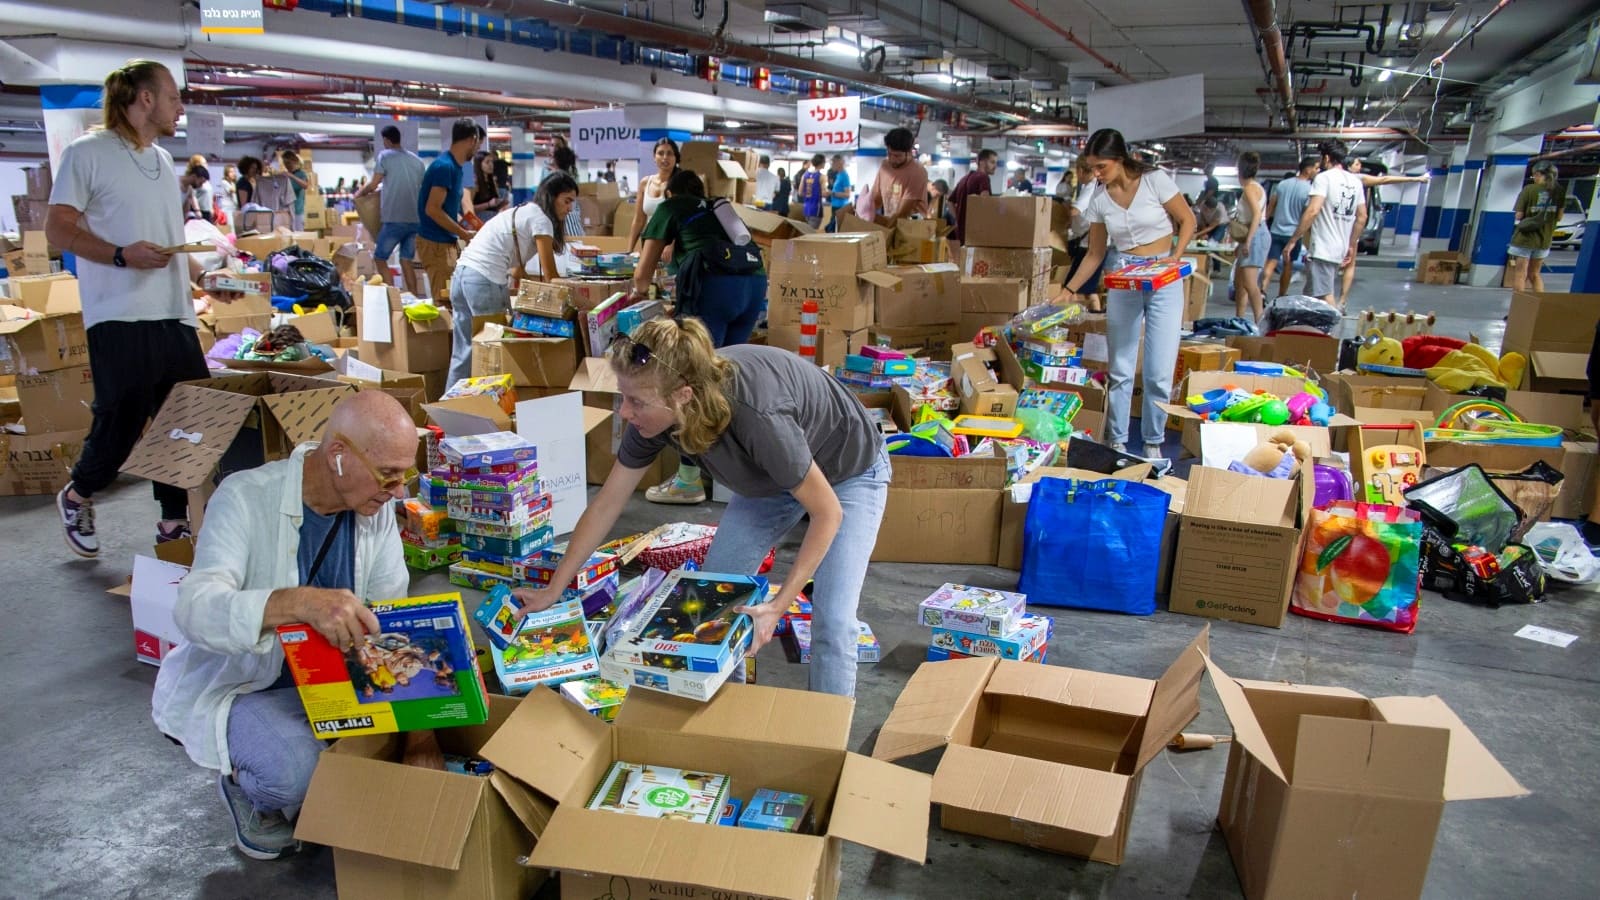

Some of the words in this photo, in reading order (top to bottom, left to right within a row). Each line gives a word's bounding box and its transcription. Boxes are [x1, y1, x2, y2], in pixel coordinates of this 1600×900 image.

[203, 7, 221, 18] בלבד
[222, 9, 239, 18] נכים
[241, 9, 261, 18] חניית
[809, 106, 847, 122] נעלי
[804, 131, 854, 146] גברים
[801, 287, 825, 299] צבר
[23, 449, 53, 461] צבר
[1190, 521, 1210, 530] Moving
[654, 642, 682, 653] 300
[648, 882, 695, 898] אריזות
